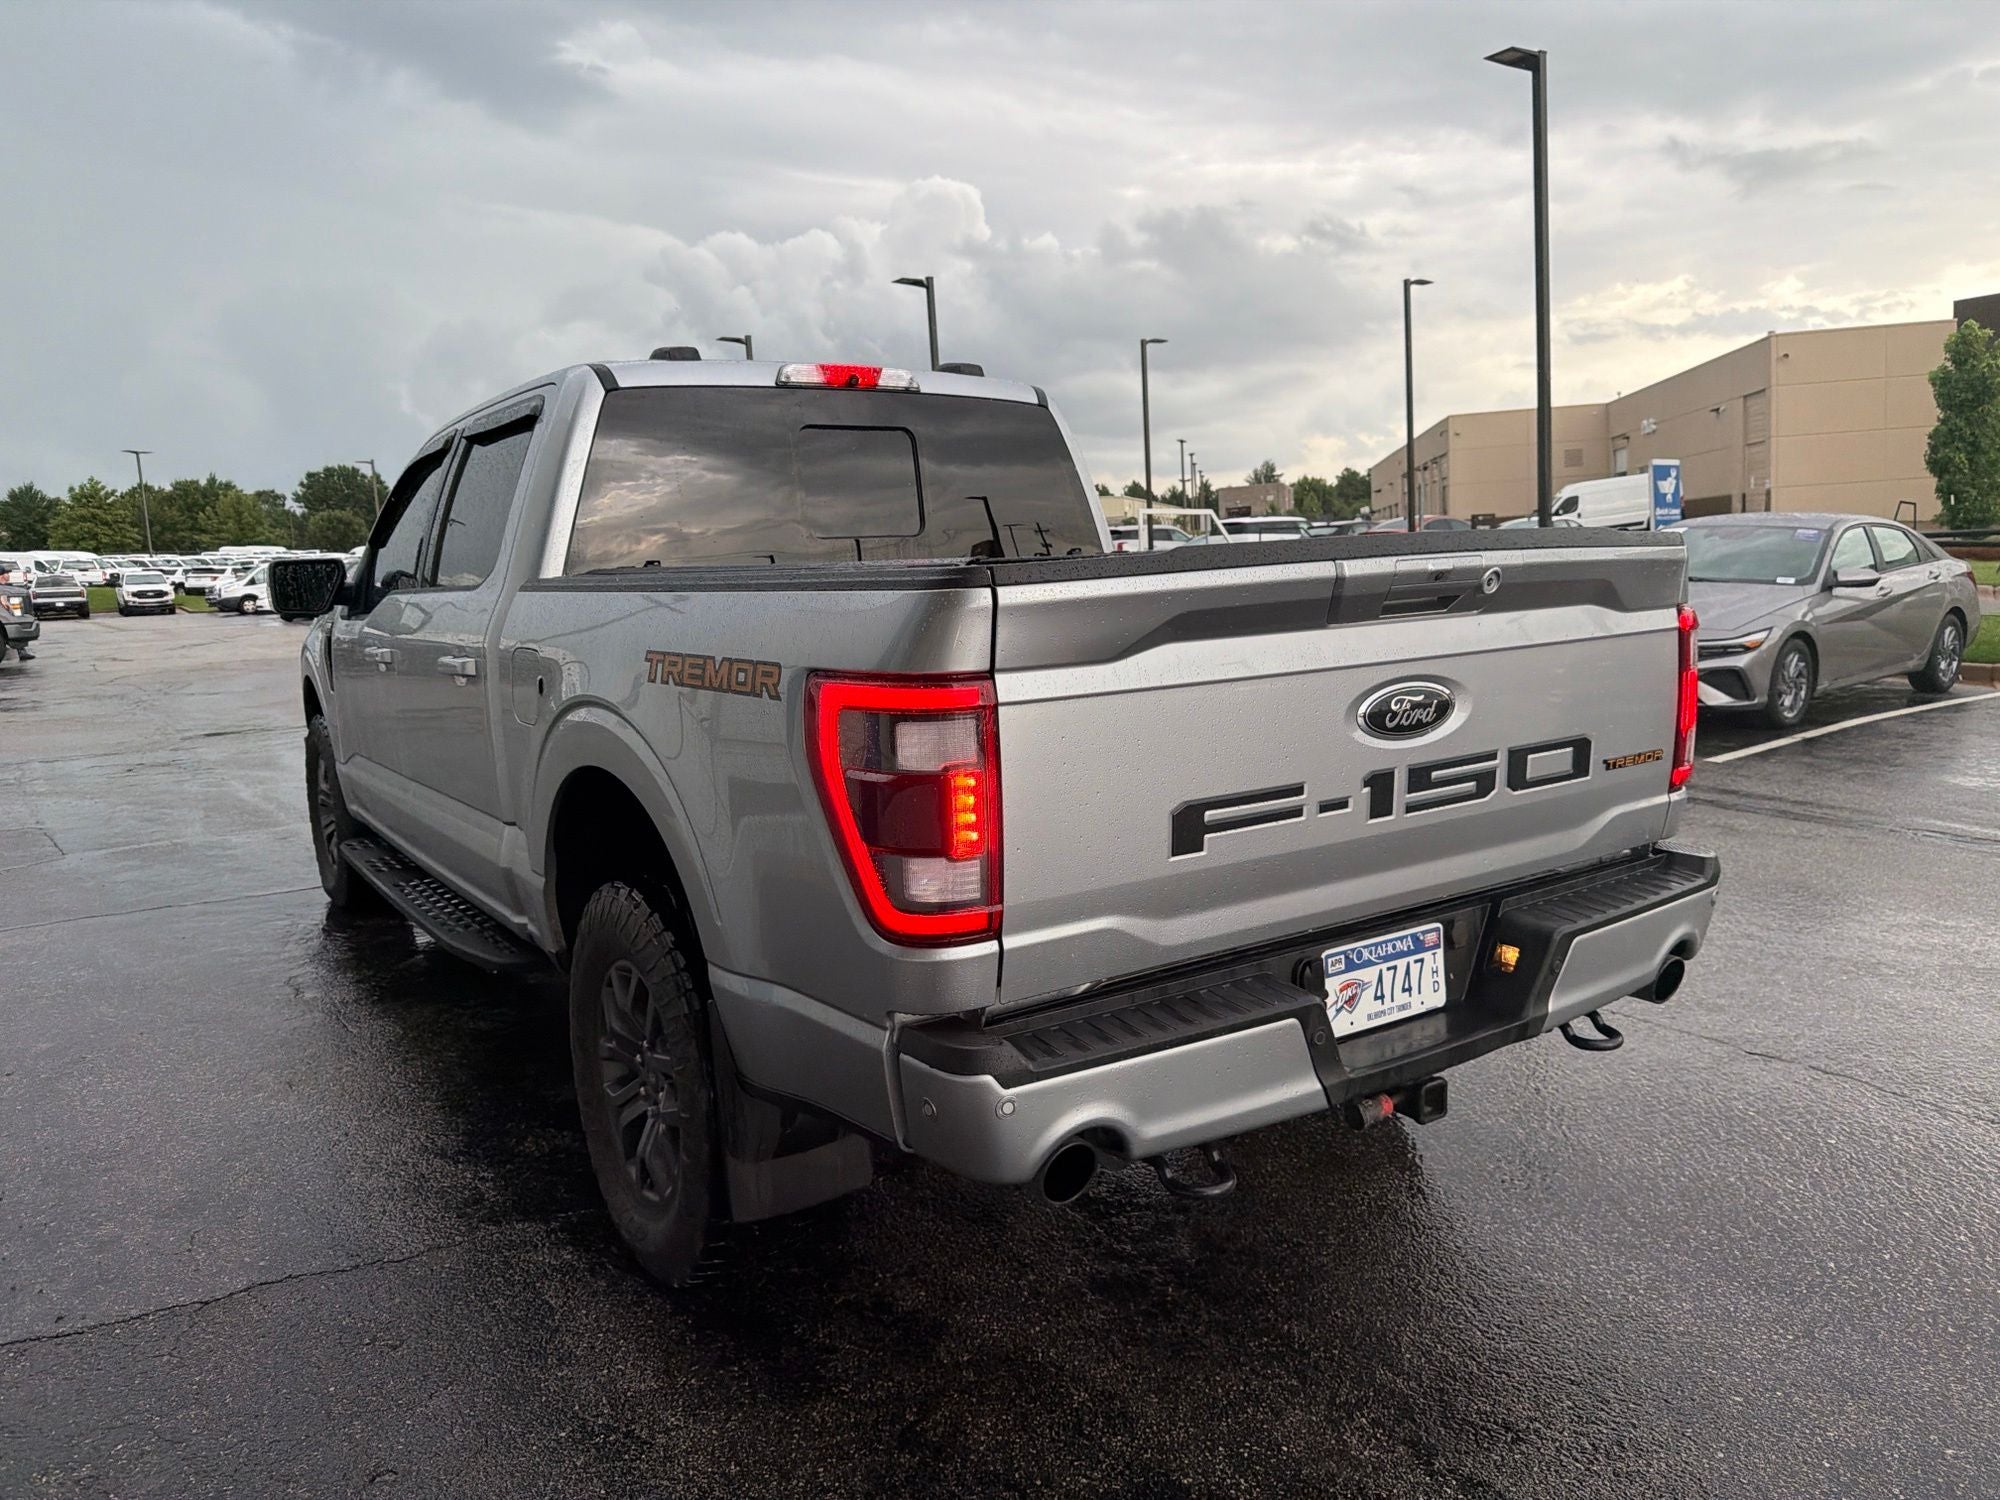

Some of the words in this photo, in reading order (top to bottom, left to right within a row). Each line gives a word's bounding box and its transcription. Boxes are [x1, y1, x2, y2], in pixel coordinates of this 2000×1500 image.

[645, 649, 782, 701] TREMOR
[1385, 694, 1438, 729] Ford
[1603, 748, 1664, 771] TREMOR
[1168, 734, 1592, 861] F-150
[1330, 957, 1343, 968] APR
[1353, 935, 1415, 964] OKLAHOMA
[1373, 957, 1425, 1006] 4747
